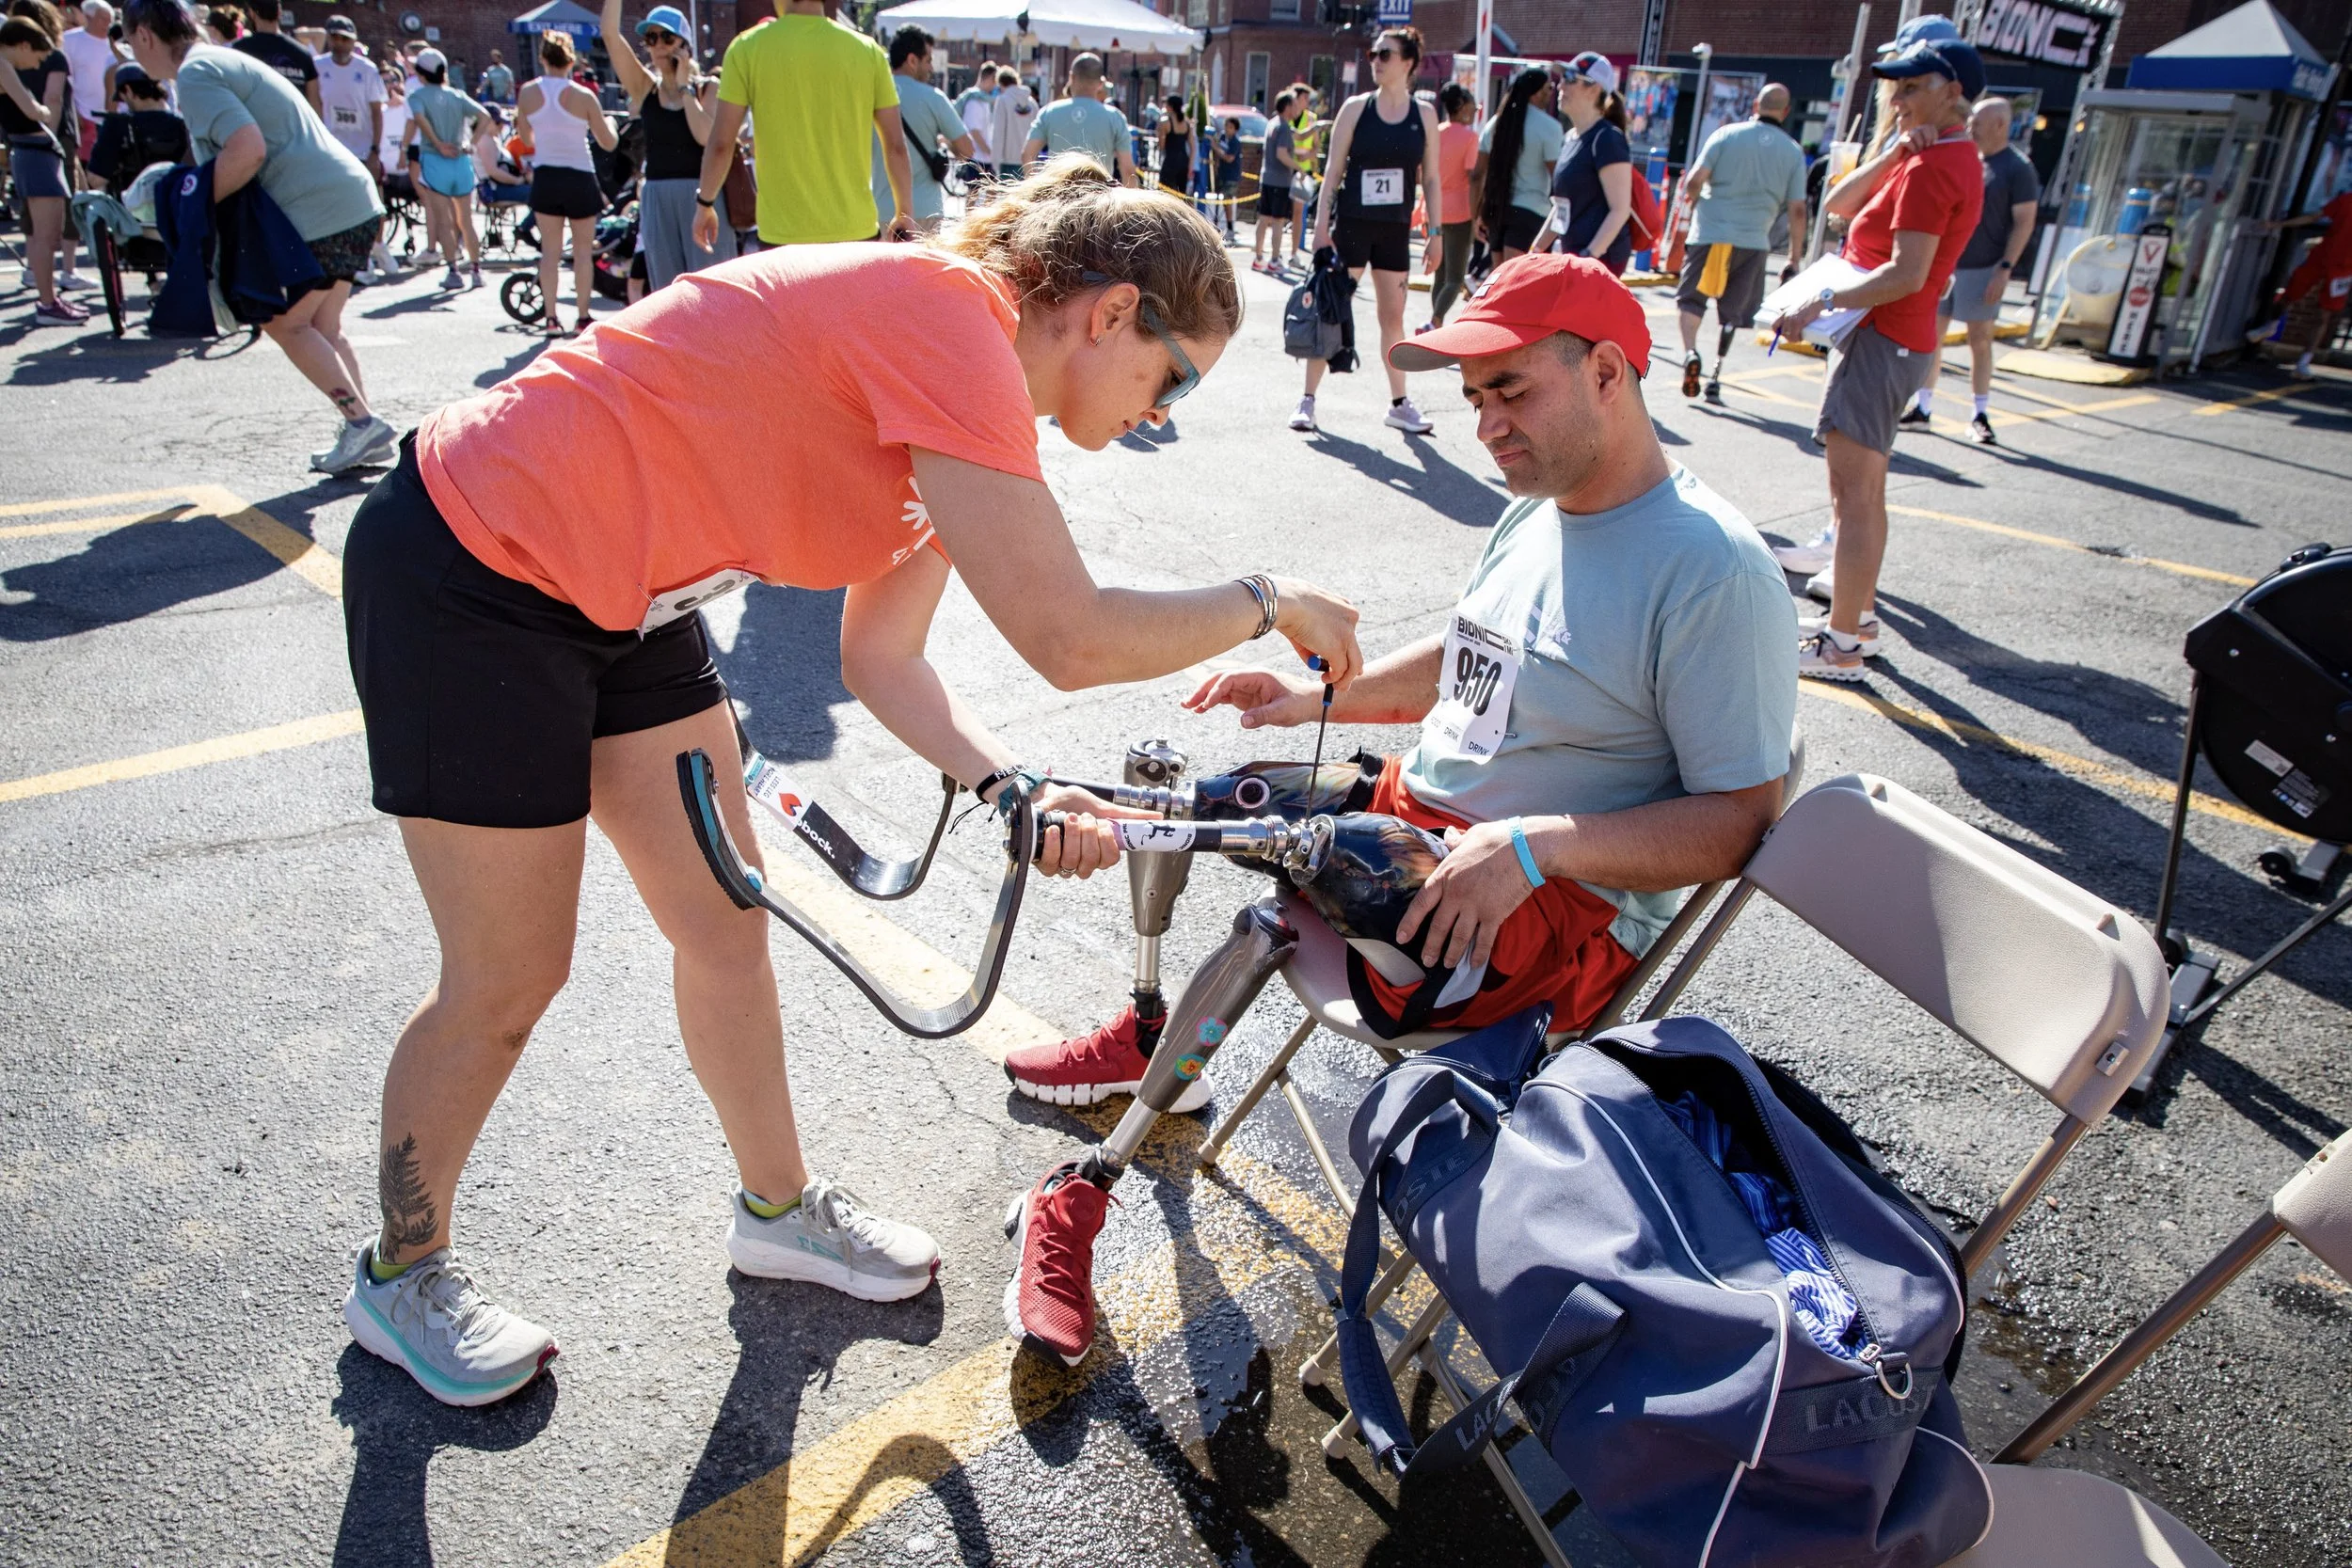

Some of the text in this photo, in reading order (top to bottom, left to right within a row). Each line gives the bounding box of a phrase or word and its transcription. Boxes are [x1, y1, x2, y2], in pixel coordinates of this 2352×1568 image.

[1379, 0, 1409, 12] EXIT
[1375, 179, 1390, 194] 21
[1454, 646, 1502, 717] 950
[1443, 726, 1459, 743] DRINK
[1468, 741, 1490, 756] DRINK
